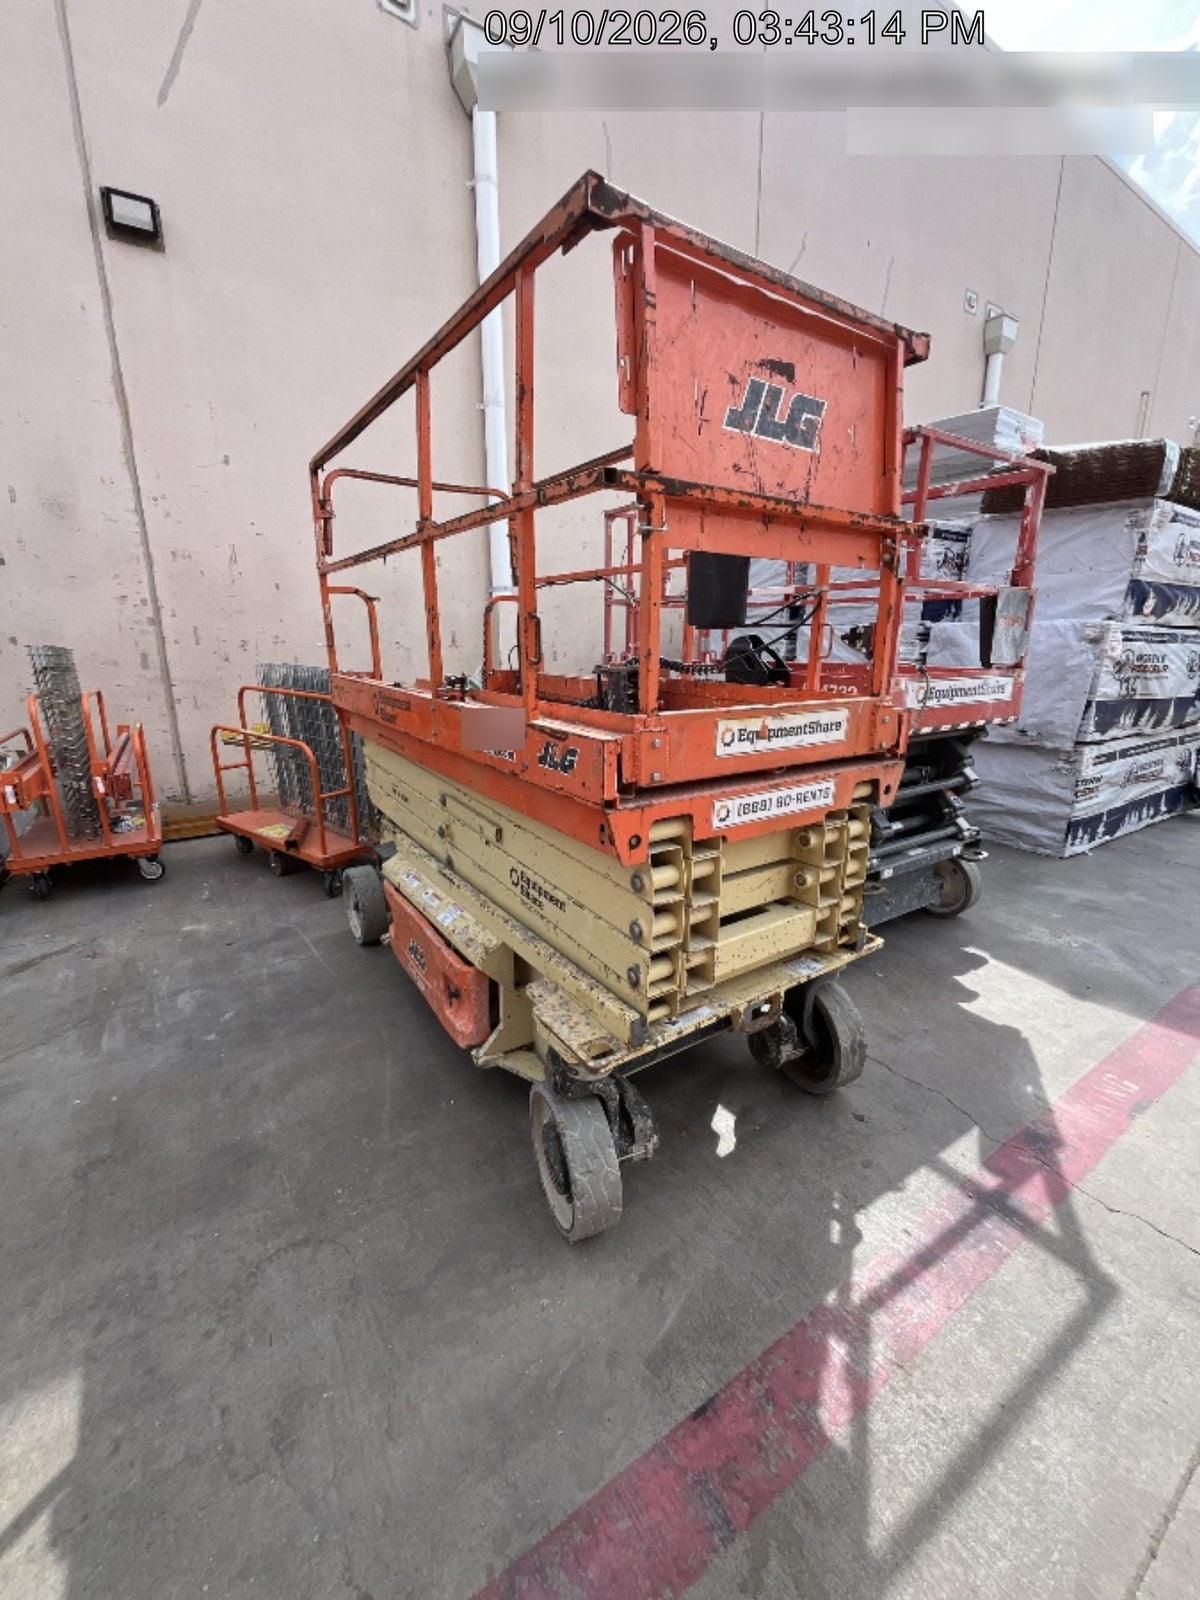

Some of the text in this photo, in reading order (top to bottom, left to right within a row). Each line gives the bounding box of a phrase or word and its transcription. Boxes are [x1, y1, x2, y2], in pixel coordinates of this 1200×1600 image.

[722, 376, 828, 454] JLG
[737, 719, 841, 745] EqupmentShare
[537, 741, 580, 776] JLG
